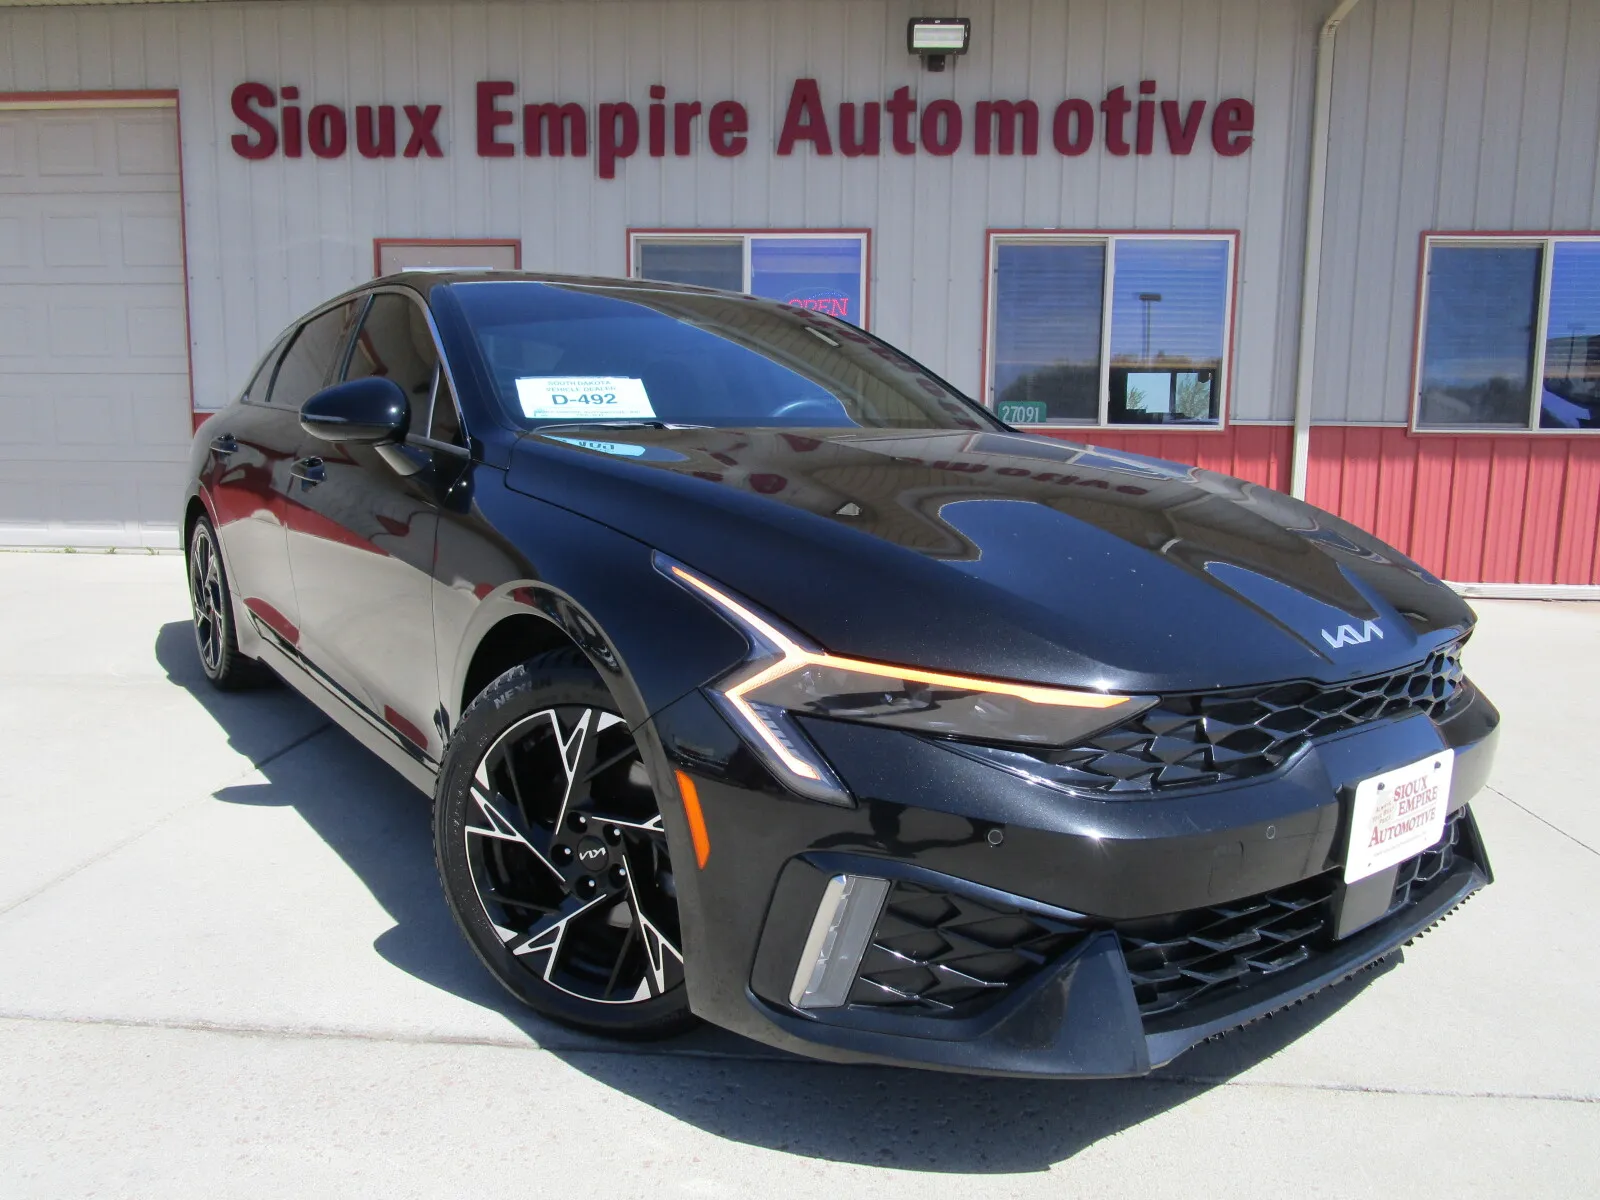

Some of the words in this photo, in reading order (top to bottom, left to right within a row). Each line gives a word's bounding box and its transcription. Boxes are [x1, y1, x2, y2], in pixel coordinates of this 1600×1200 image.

[231, 82, 445, 160] Sioux
[476, 80, 749, 180] Empire
[777, 78, 1255, 158] Automotive
[551, 393, 618, 405] D-492
[1002, 405, 1039, 423] 27091
[1321, 620, 1384, 649] KIA
[1393, 775, 1428, 802] SIOUX
[1398, 785, 1439, 817] EMPIRE
[1368, 807, 1436, 848] AUTOMOTIVE
